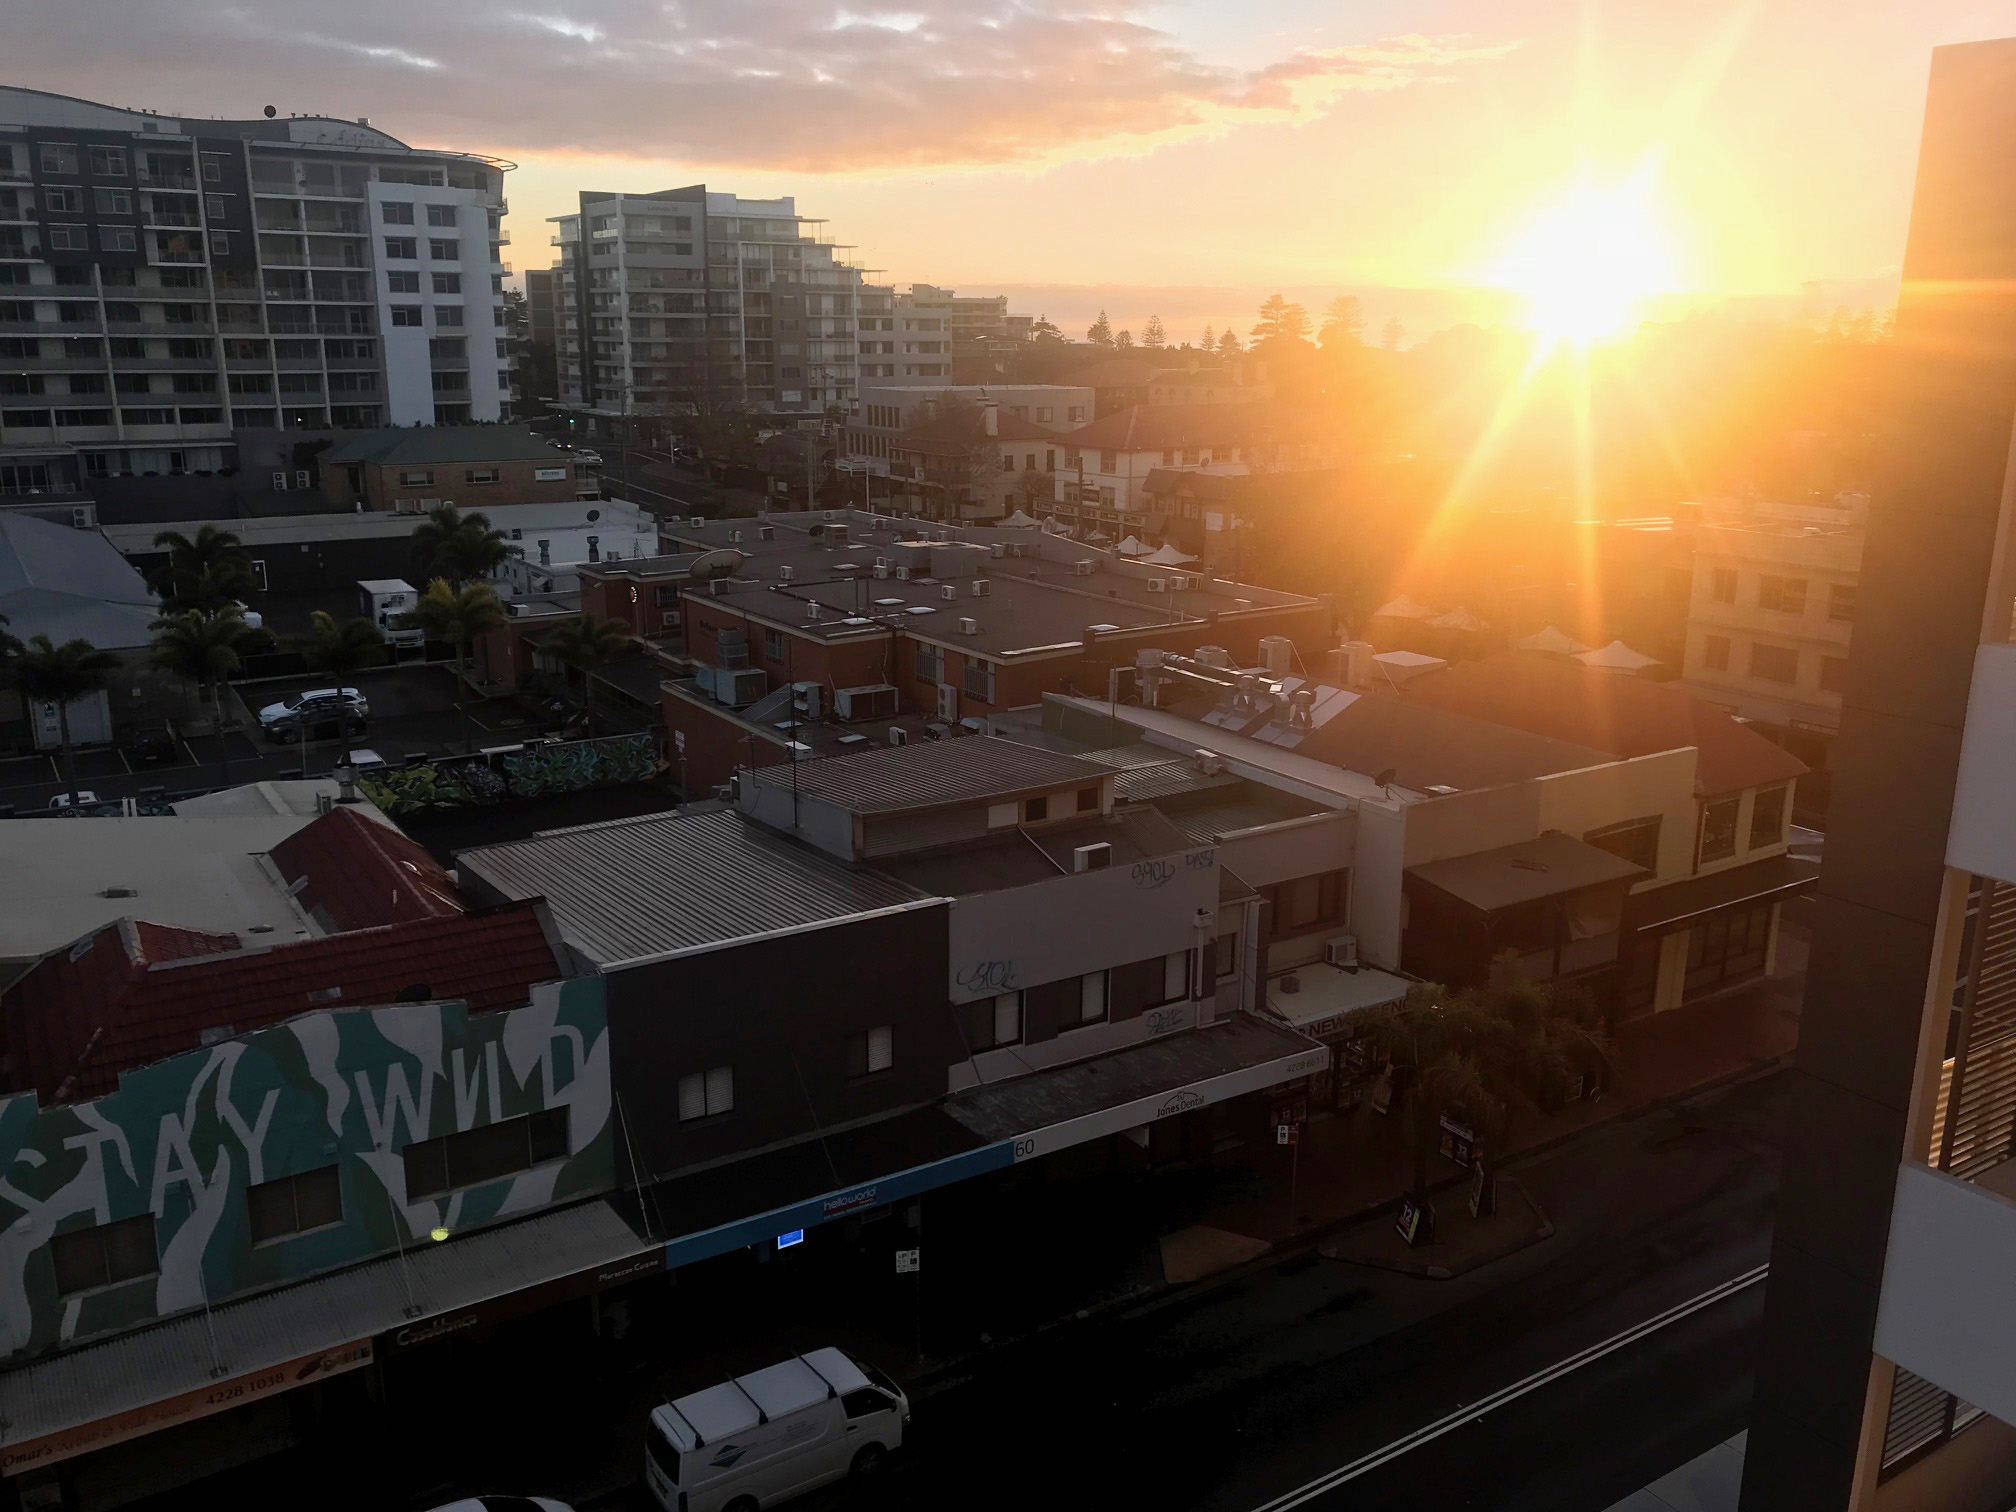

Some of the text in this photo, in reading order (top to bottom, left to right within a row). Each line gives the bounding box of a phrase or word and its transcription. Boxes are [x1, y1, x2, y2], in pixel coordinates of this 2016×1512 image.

[1157, 1095, 1206, 1118] Jones Dental
[1015, 1138, 1035, 1158] 60
[634, 1260, 660, 1272] Cuisine
[2, 1444, 53, 1467] Omar's
[206, 1385, 244, 1405] 4228
[248, 1372, 286, 1392] 1038
